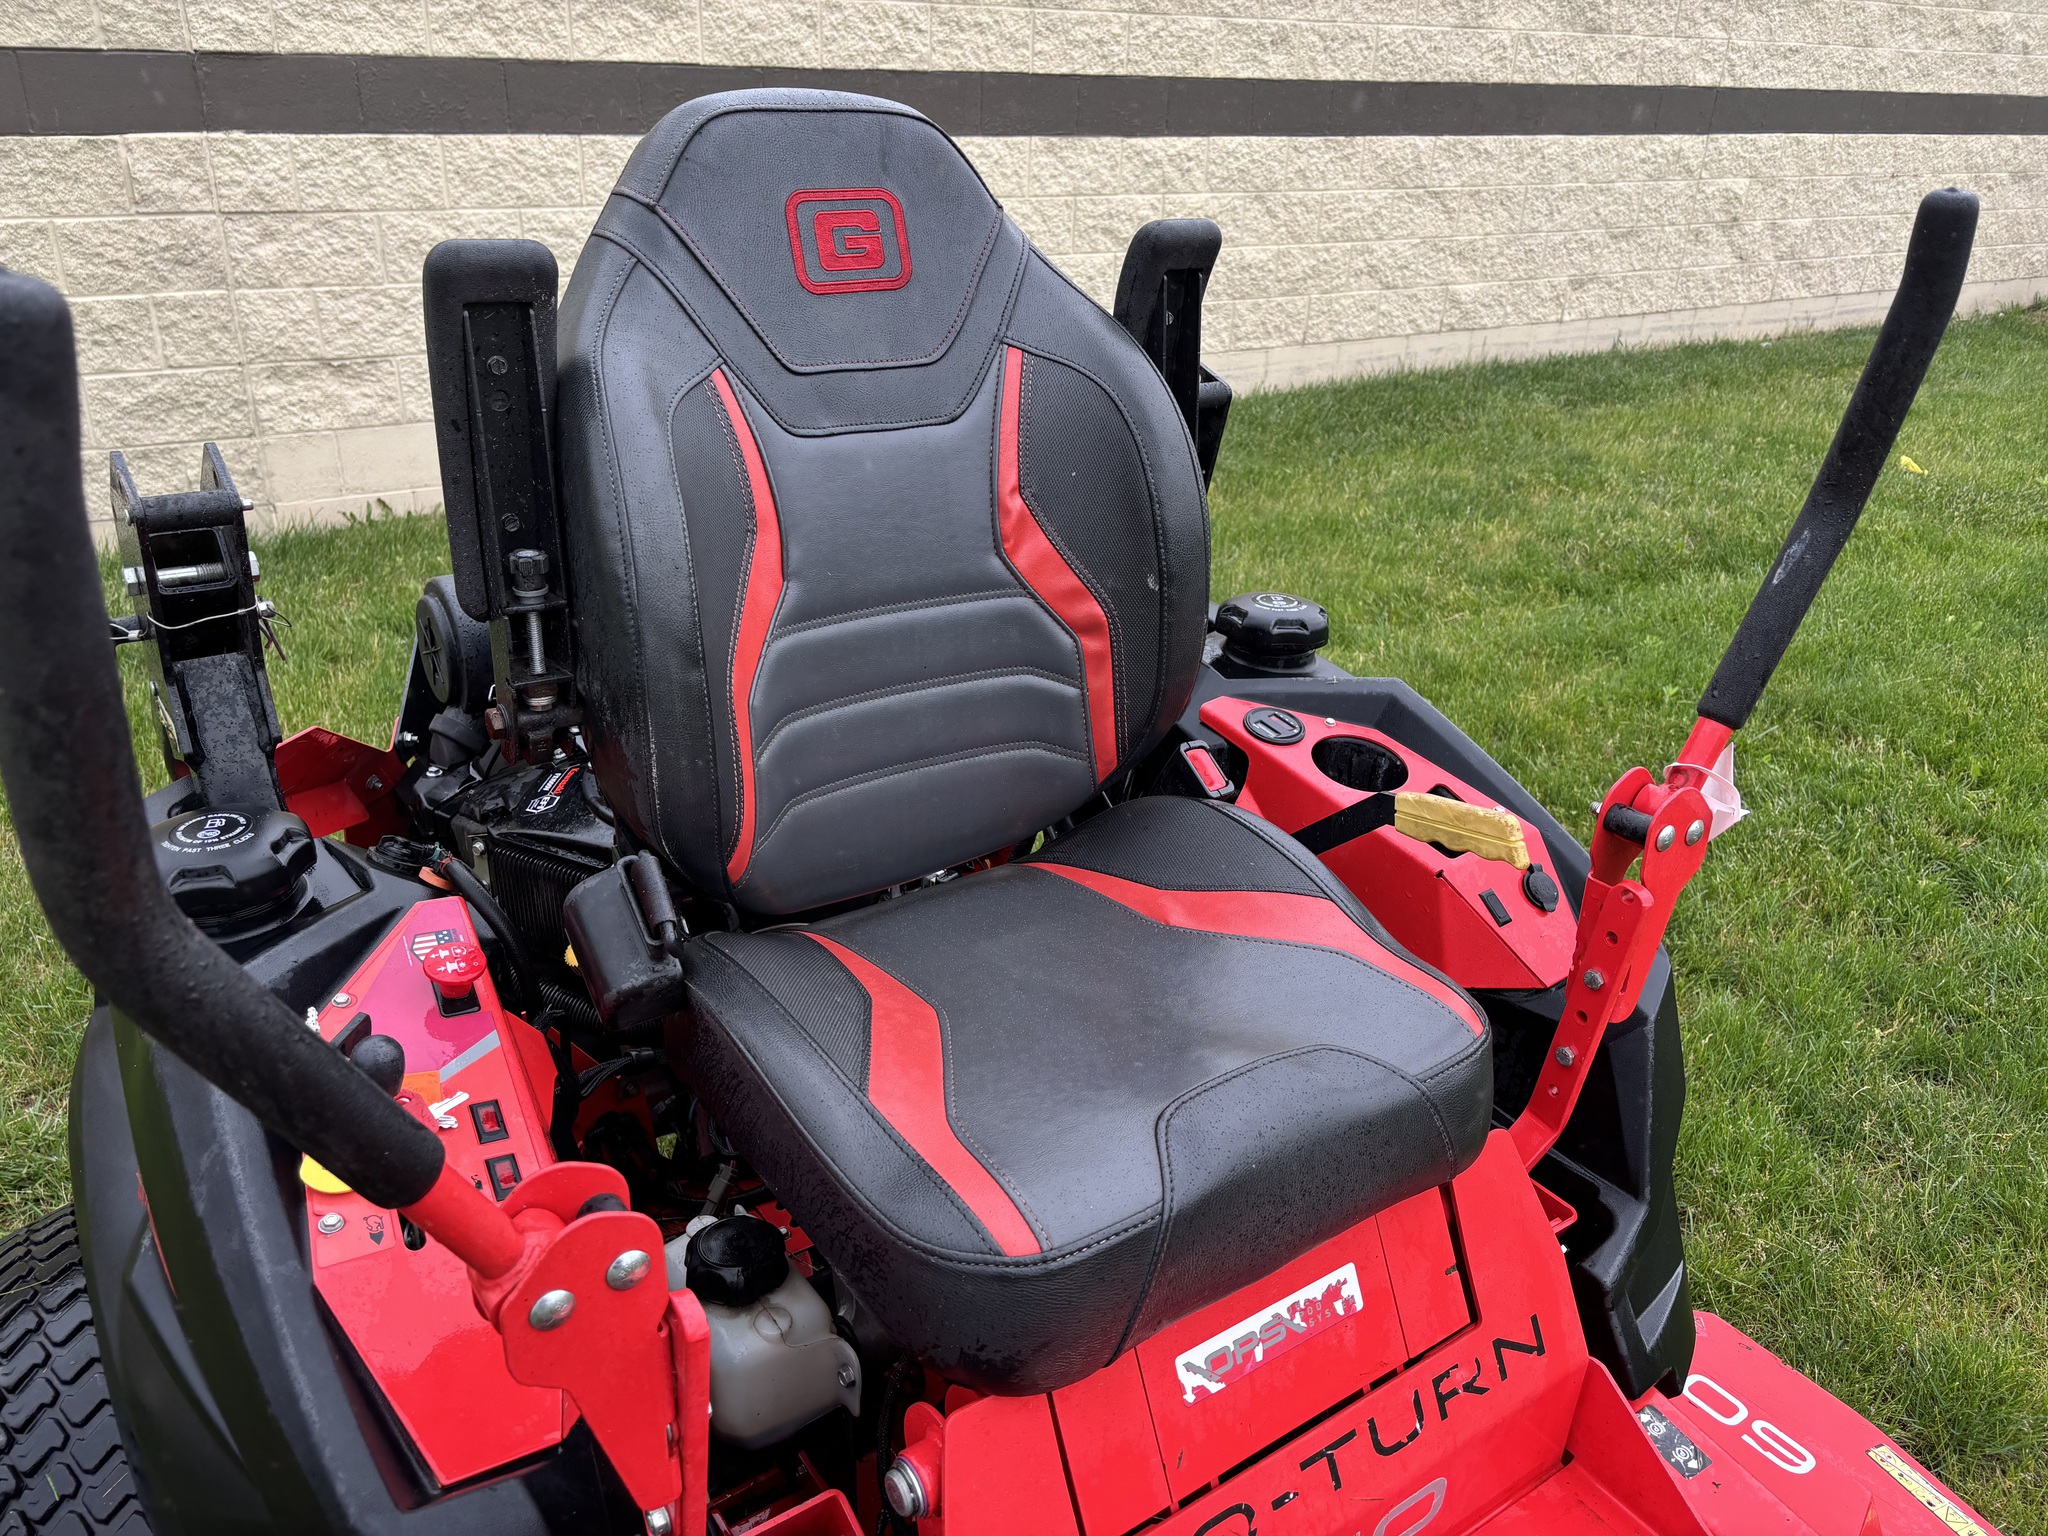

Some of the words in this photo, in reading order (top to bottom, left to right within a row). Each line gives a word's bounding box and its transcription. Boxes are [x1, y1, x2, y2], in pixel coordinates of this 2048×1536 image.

[814, 209, 885, 272] G
[206, 843, 231, 852] THREE
[232, 832, 255, 844] CLICKS
